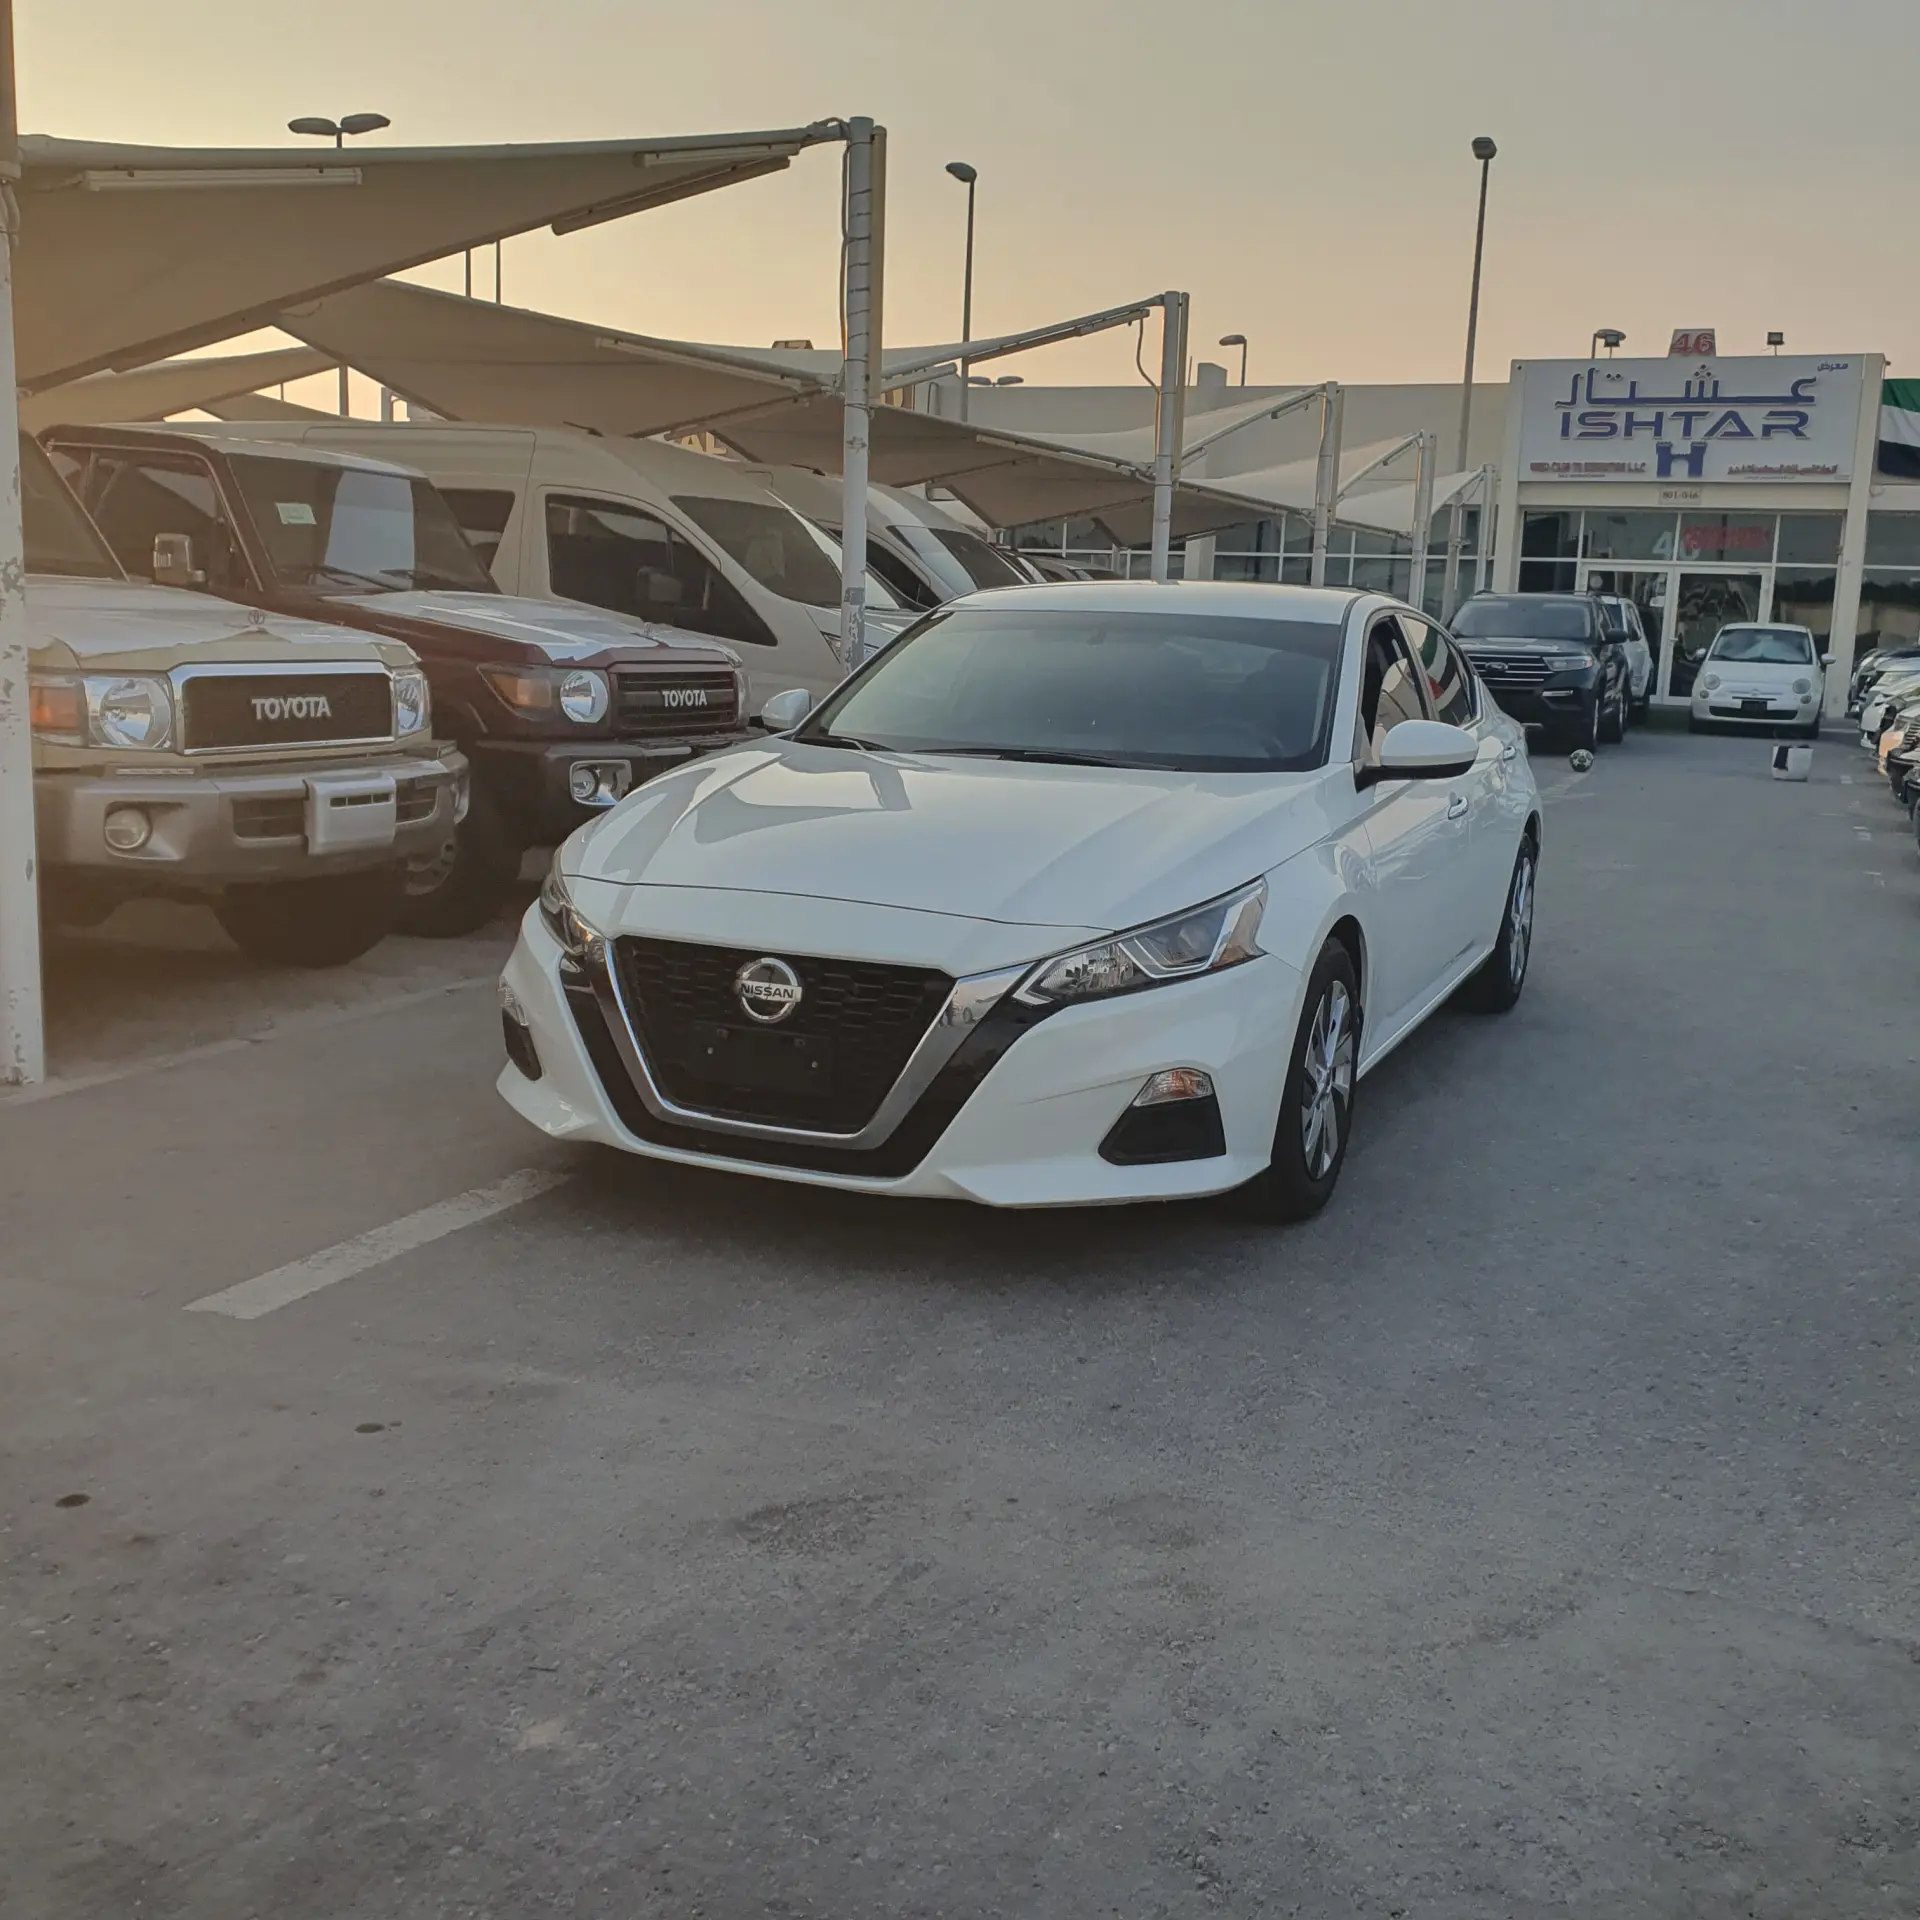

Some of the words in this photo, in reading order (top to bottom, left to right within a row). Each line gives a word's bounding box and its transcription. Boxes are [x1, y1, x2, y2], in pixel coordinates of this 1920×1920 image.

[1671, 333, 1714, 356] 46
[1554, 364, 1817, 407] عشتار
[1560, 410, 1811, 440] ISHTAR
[251, 696, 332, 720] TOYOTA
[662, 689, 708, 707] TOYOTA
[741, 983, 794, 999] NISSAN
